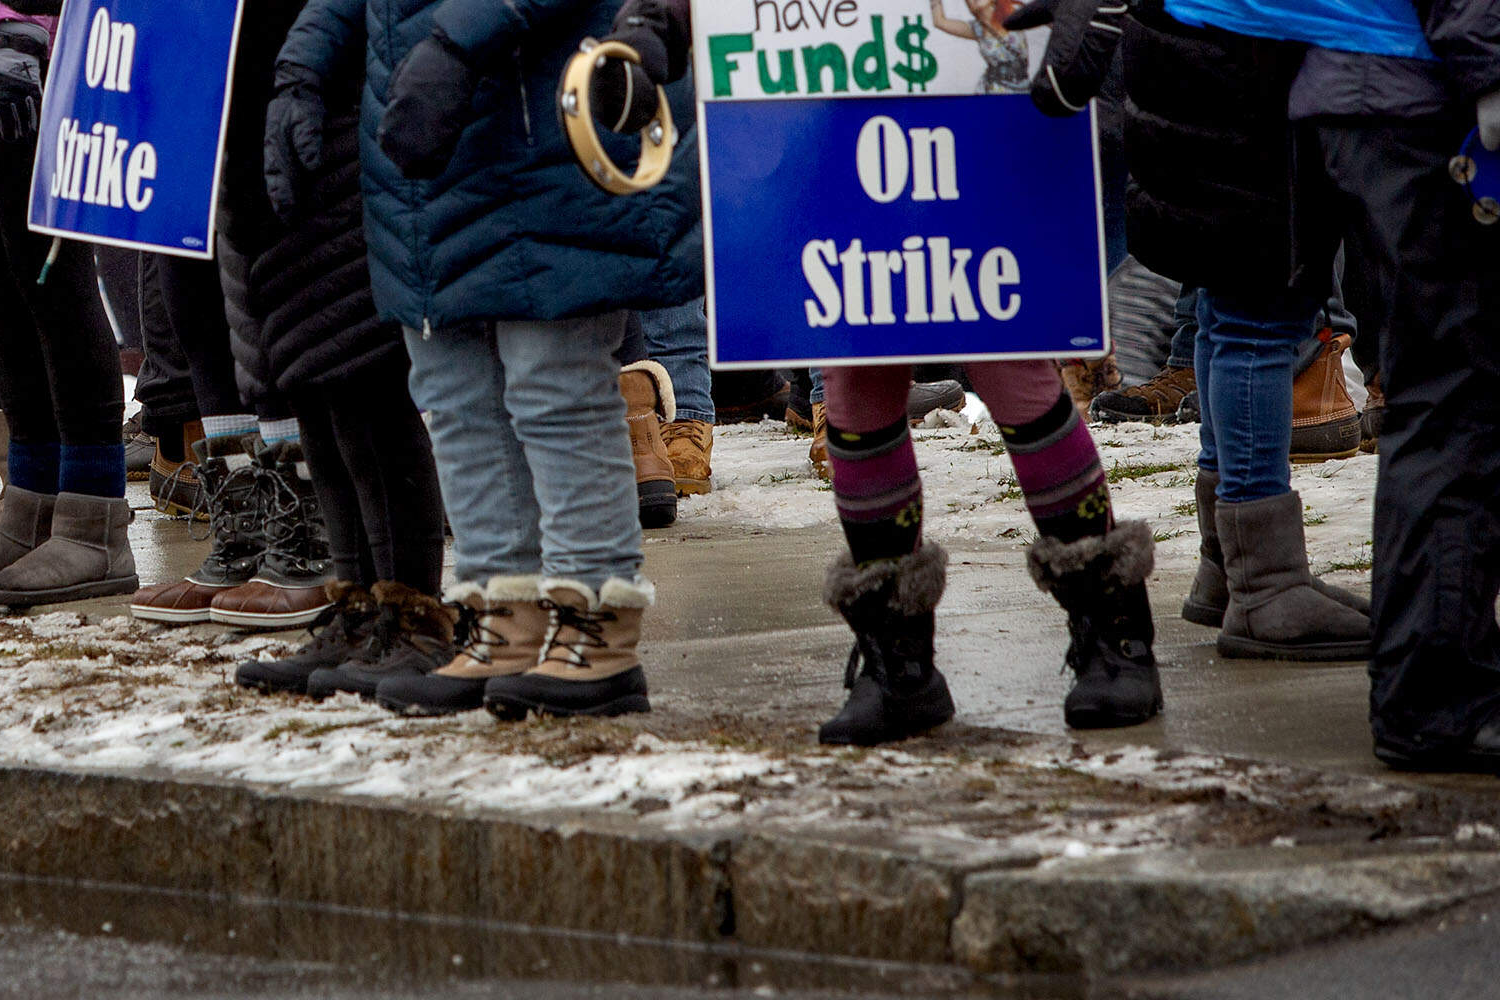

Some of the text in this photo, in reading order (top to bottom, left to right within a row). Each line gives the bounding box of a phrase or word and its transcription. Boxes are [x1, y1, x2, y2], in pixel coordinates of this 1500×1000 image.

[85, 6, 136, 93] On
[707, 14, 938, 97] Fund$
[51, 117, 158, 213] Strike
[856, 115, 960, 204] On
[802, 236, 1021, 329] Strike
